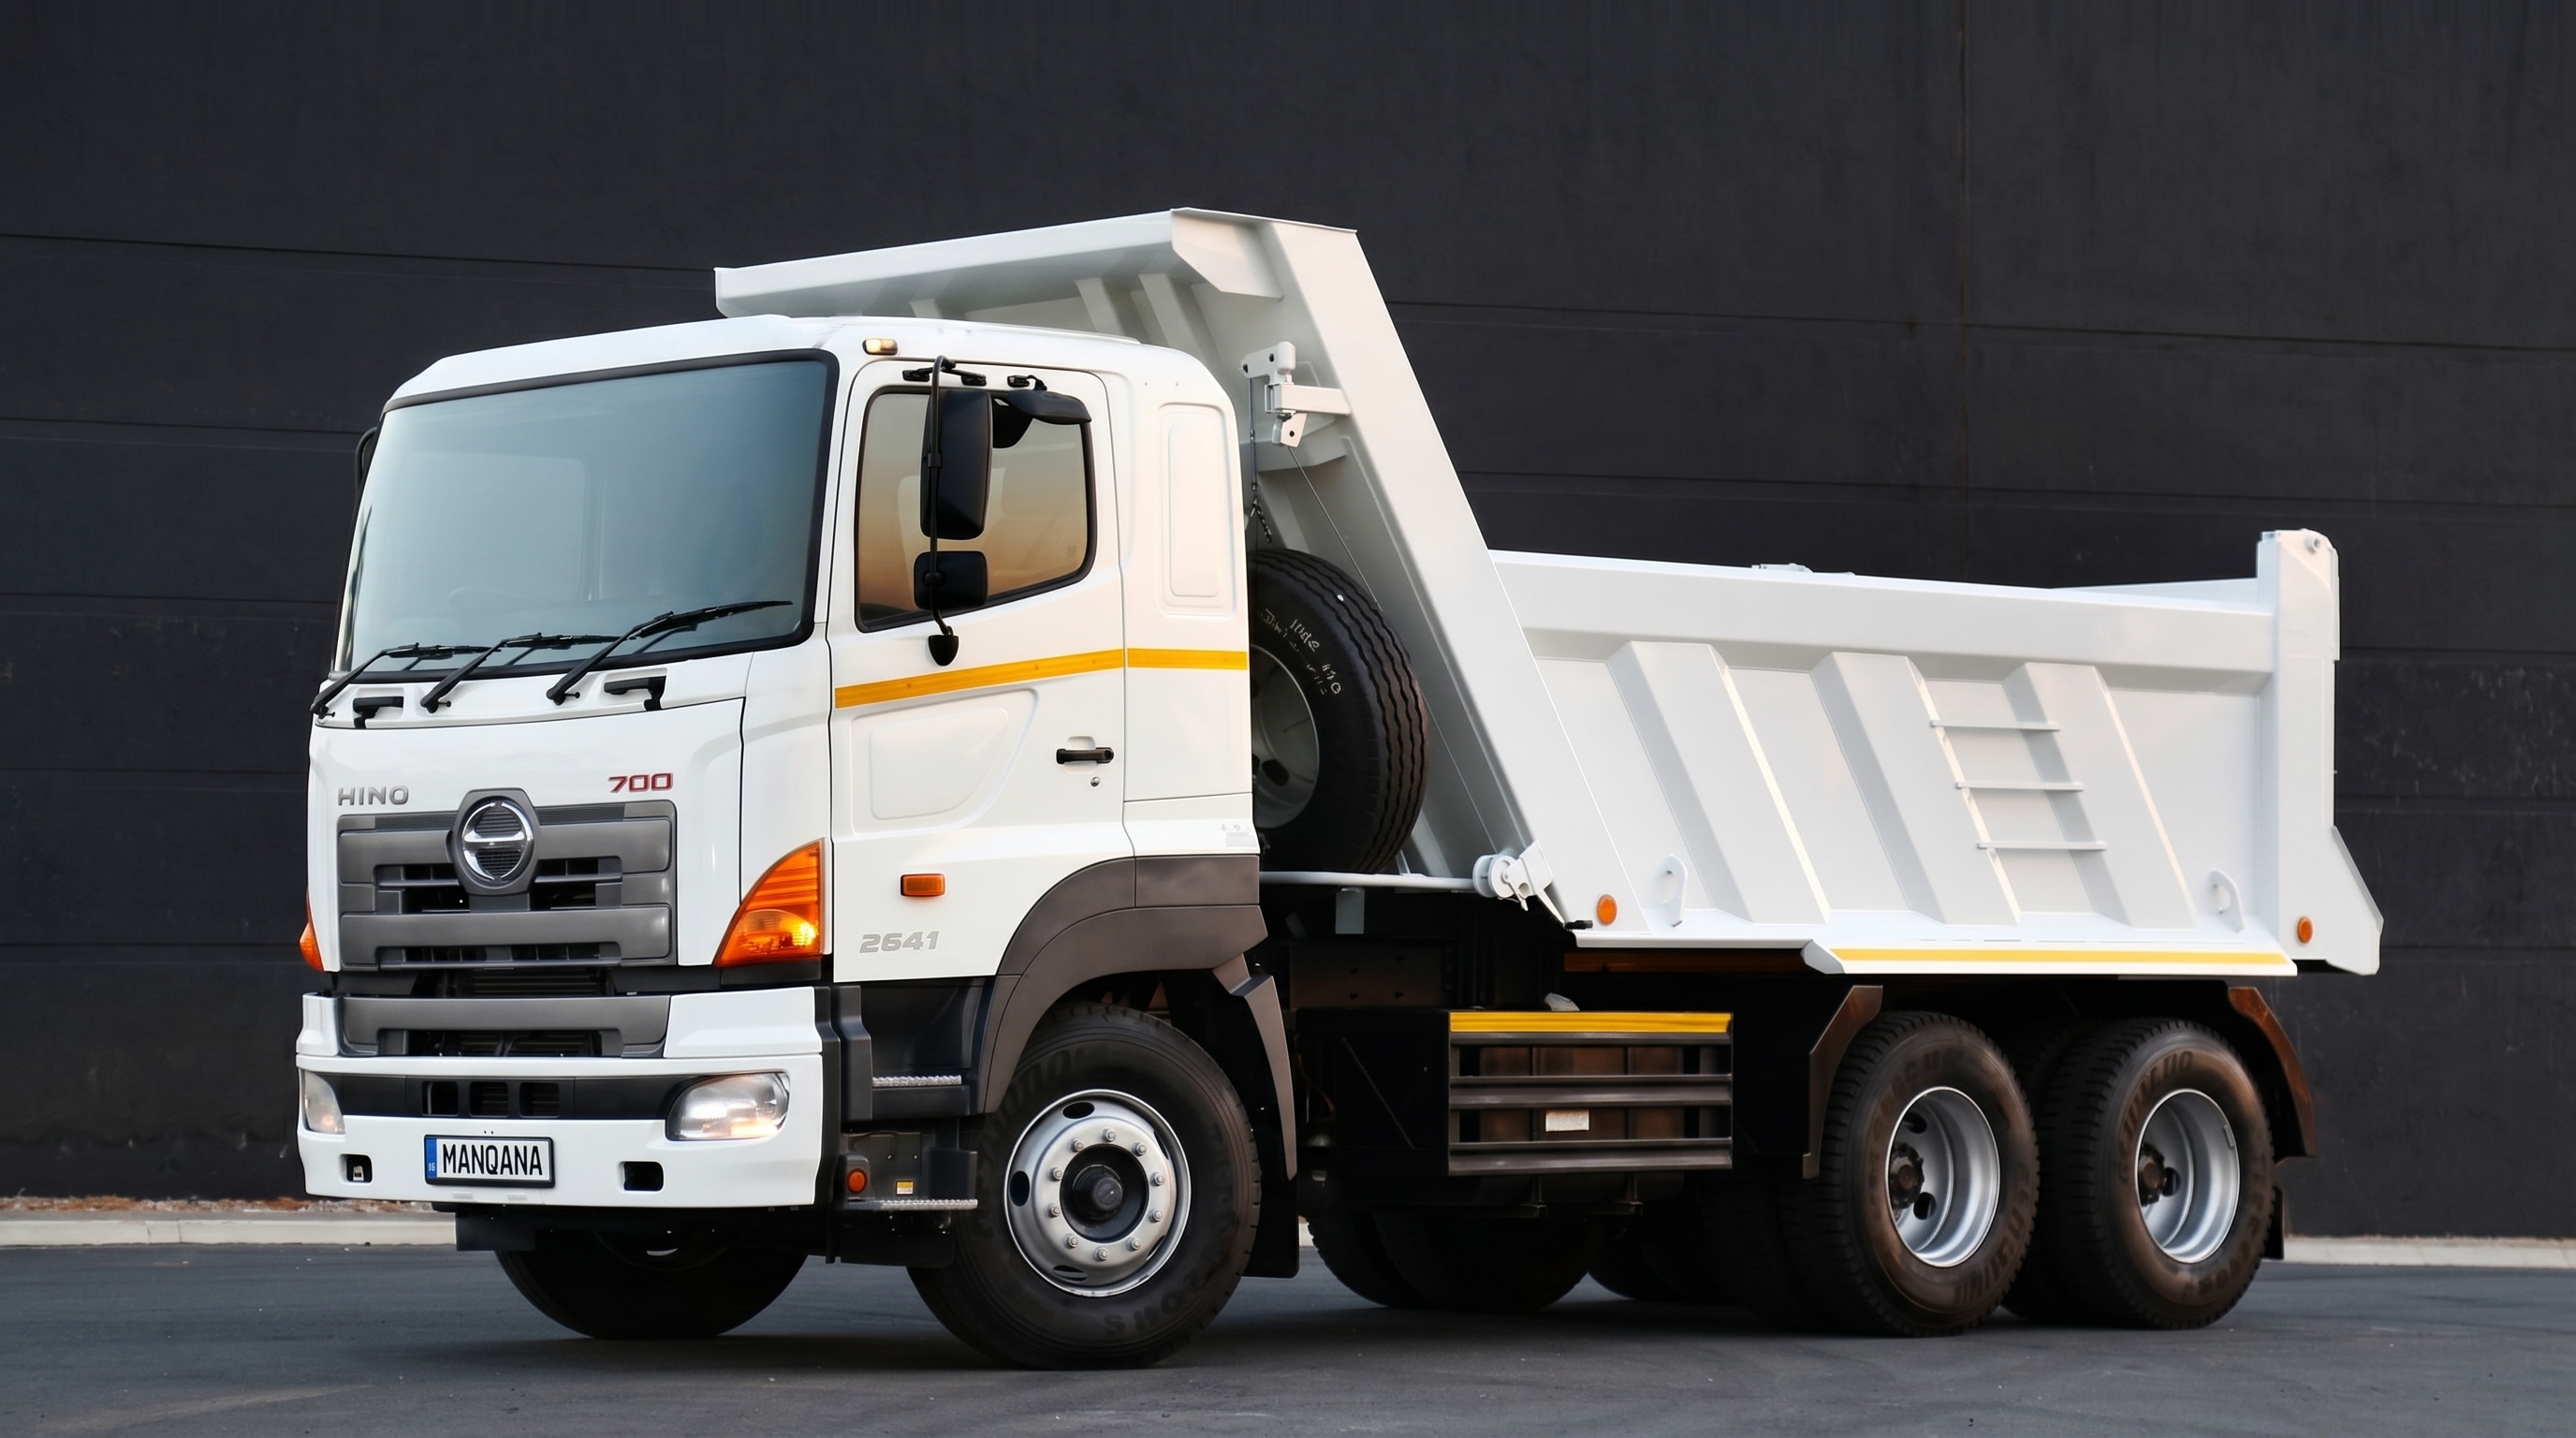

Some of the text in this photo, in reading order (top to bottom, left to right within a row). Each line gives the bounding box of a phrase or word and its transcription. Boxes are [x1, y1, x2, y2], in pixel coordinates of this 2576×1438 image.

[608, 772, 673, 793] 700
[338, 785, 409, 806] HINO
[859, 931, 940, 953] 2641
[443, 1143, 543, 1176] MANQANA
